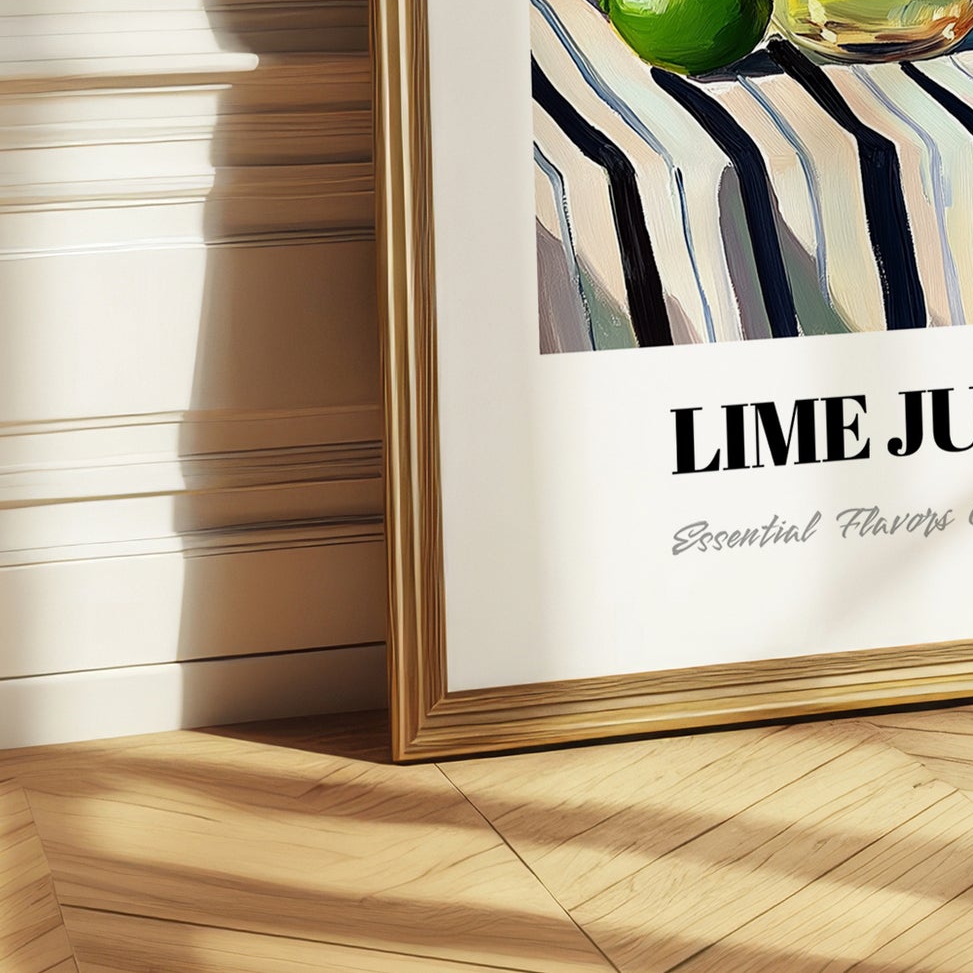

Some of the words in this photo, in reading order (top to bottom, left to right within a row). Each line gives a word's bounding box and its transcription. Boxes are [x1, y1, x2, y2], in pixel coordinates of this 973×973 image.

[670, 394, 871, 475] LIME
[671, 510, 823, 556] Essential
[835, 505, 956, 539] Flavors
